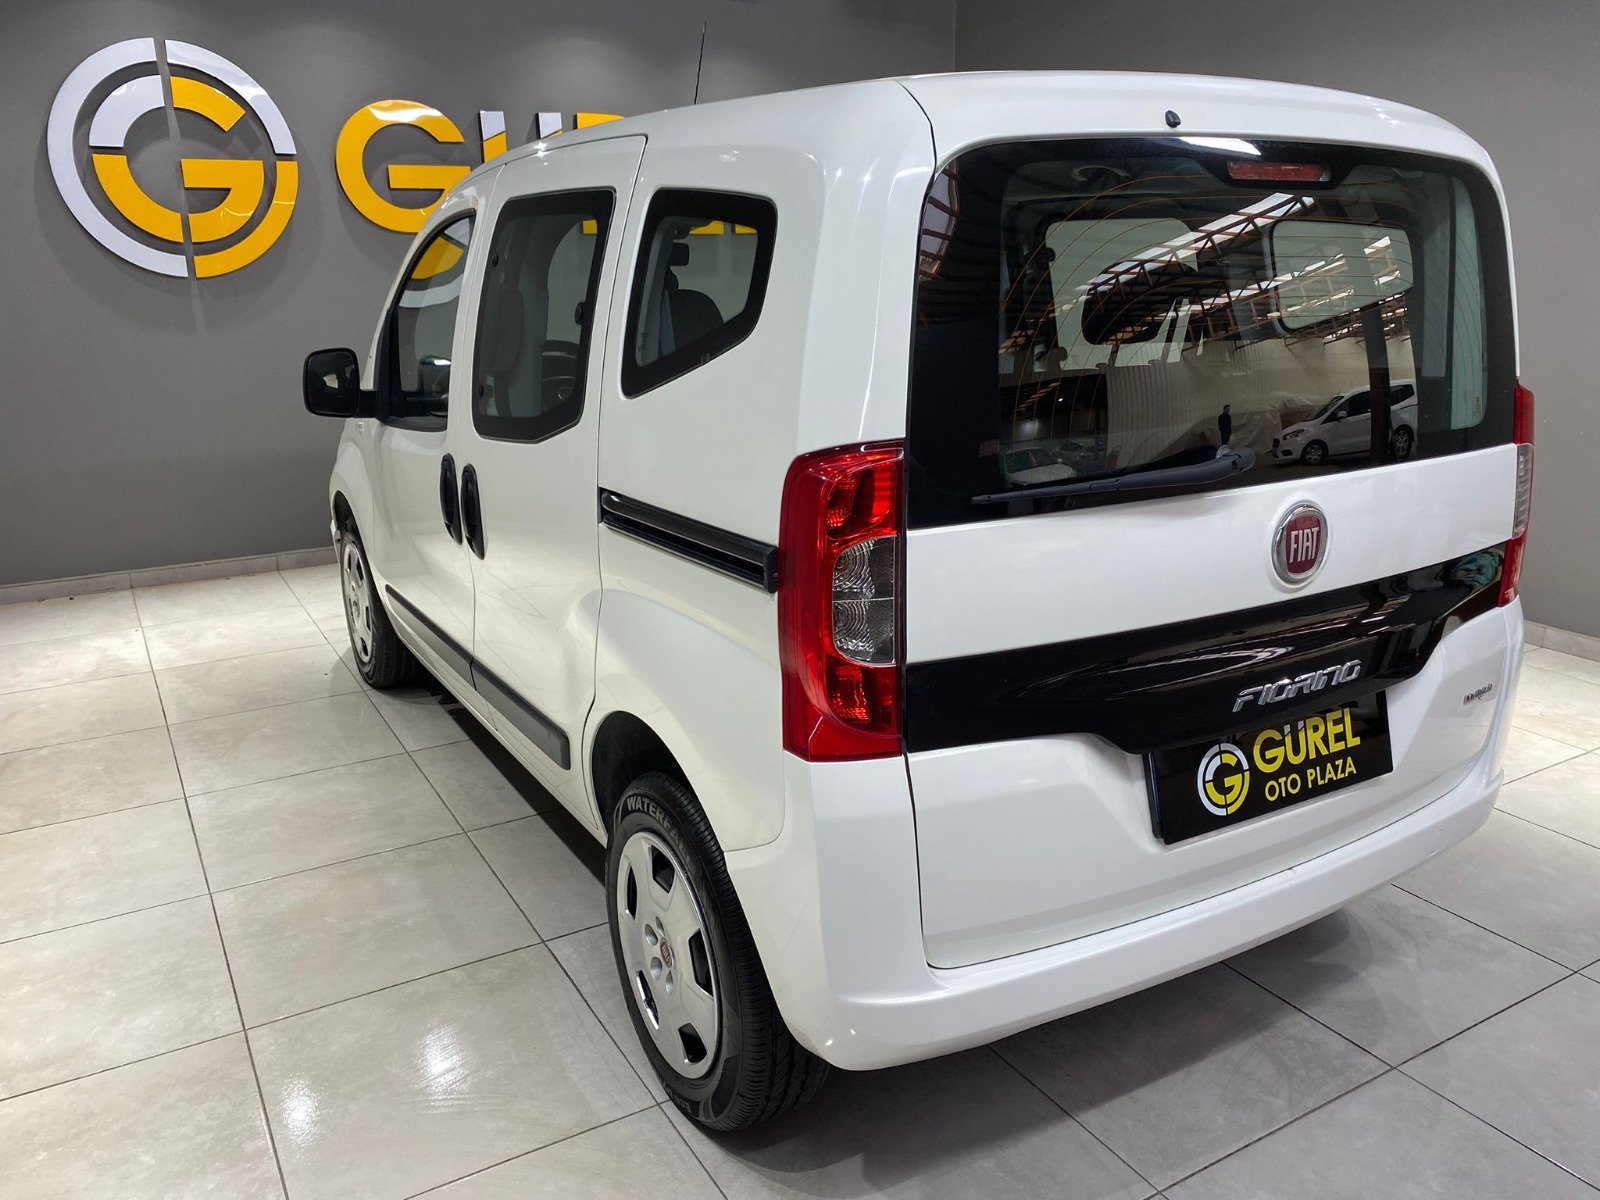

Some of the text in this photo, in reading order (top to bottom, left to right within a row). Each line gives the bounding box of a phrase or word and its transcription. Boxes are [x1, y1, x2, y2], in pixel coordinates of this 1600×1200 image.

[1289, 526, 1320, 564] FIAT
[1264, 756, 1357, 802] OTO PLAZA
